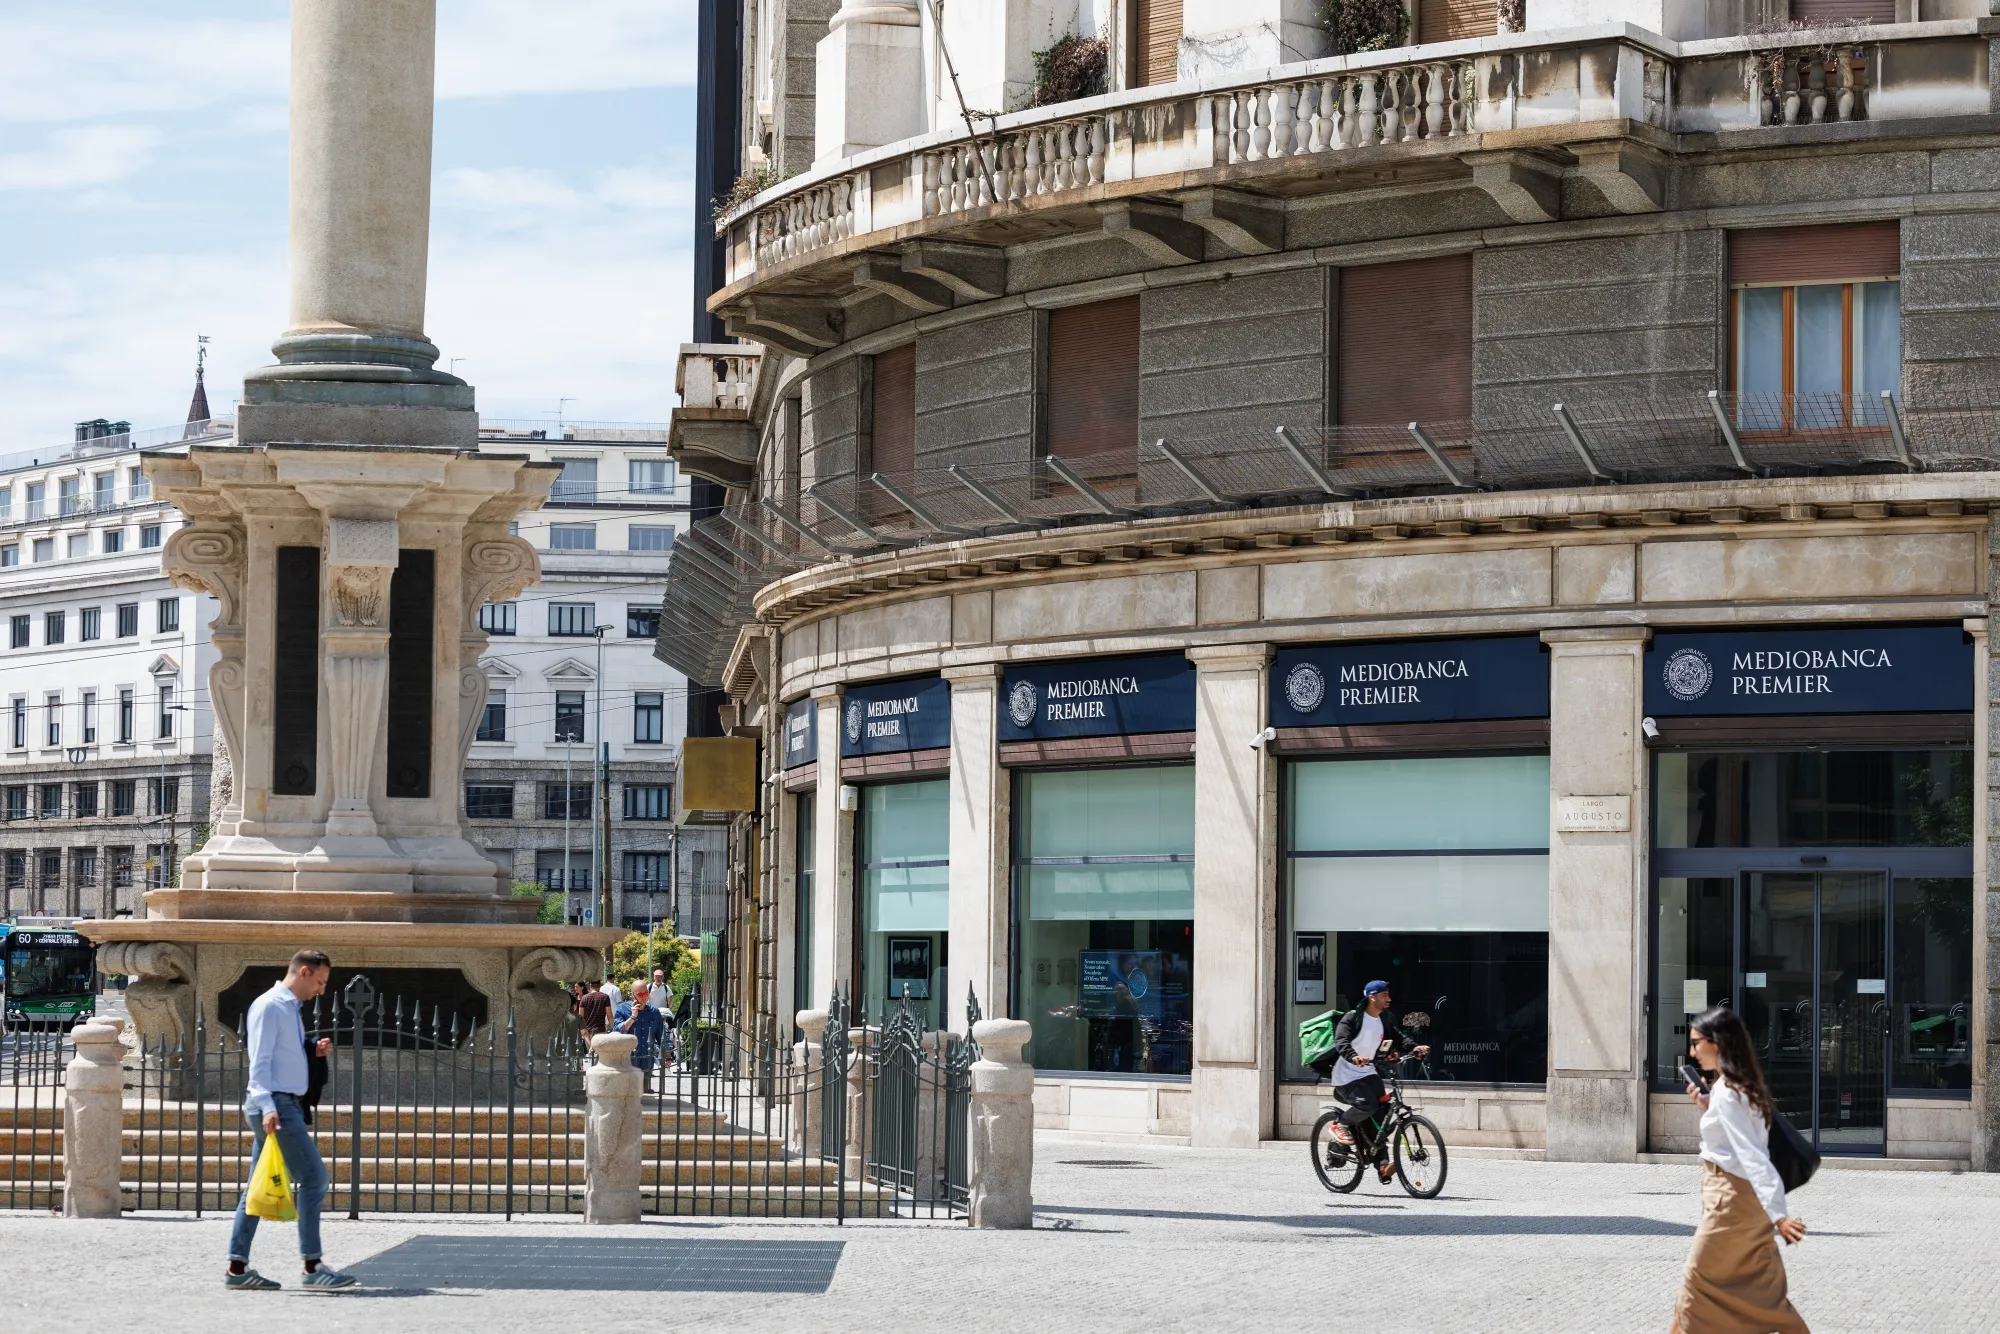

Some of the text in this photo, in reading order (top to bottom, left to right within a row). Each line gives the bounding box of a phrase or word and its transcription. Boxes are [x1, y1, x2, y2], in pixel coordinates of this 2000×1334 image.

[1732, 648, 1892, 670] MEDIOBANCA
[1340, 659, 1469, 683] MEDIOBANCA
[1047, 676, 1139, 699] MEDIOBANCA
[1732, 675, 1833, 695] PREMIER
[1340, 685, 1421, 706] PREMIER
[867, 696, 919, 718] MEDIOBANCA
[1047, 701, 1106, 720] PREMIER
[867, 719, 900, 738] PREMIER
[1565, 812, 1622, 821] AUGUSTO
[18, 933, 31, 944] 60
[1443, 1041, 1500, 1052] MEDIOBANCA
[1443, 1054, 1480, 1064] PREMIER
